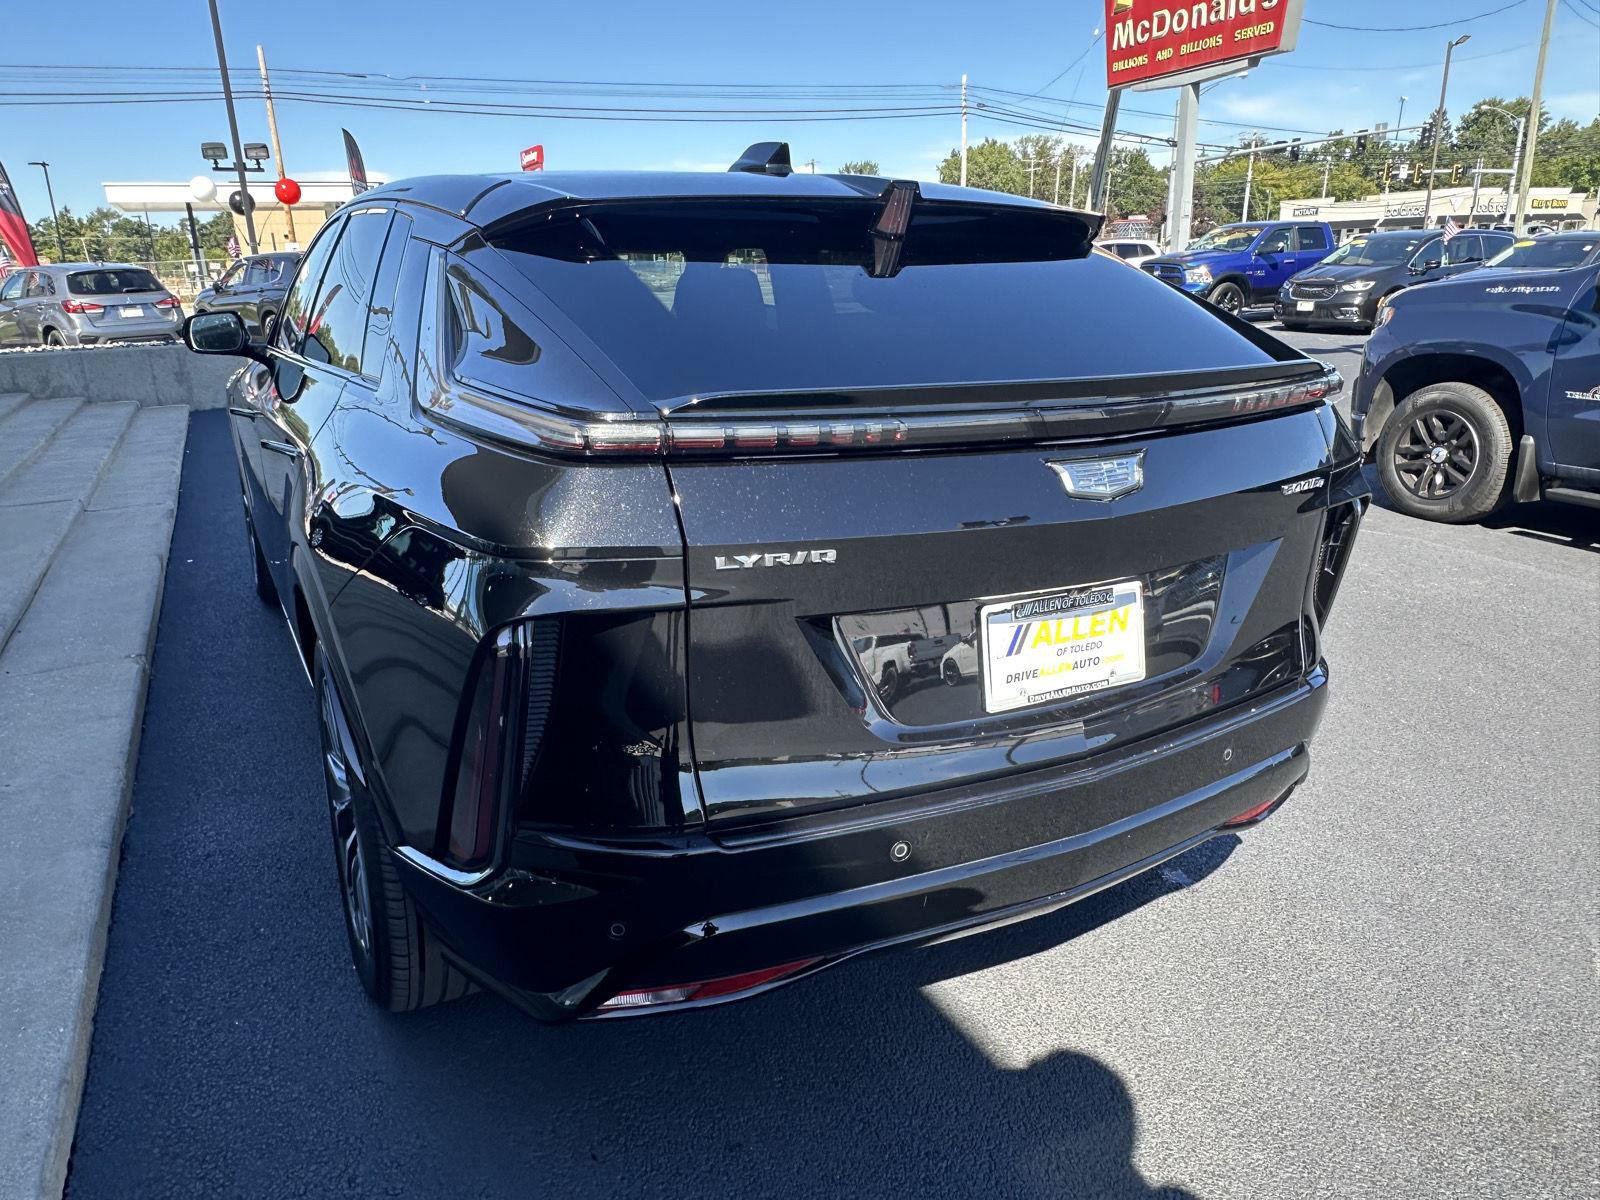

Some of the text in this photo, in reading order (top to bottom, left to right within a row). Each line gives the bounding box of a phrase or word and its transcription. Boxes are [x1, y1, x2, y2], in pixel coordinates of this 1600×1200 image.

[1112, 0, 1279, 50] McDonal
[1112, 21, 1275, 72] BILLIONS AND BILLIONS SERVED
[714, 549, 837, 570] LYRIQ
[1032, 592, 1106, 614] ALLEN OF TOLEDO
[1031, 606, 1129, 648] ALLEN
[1057, 641, 1102, 656] OF TOLEDO
